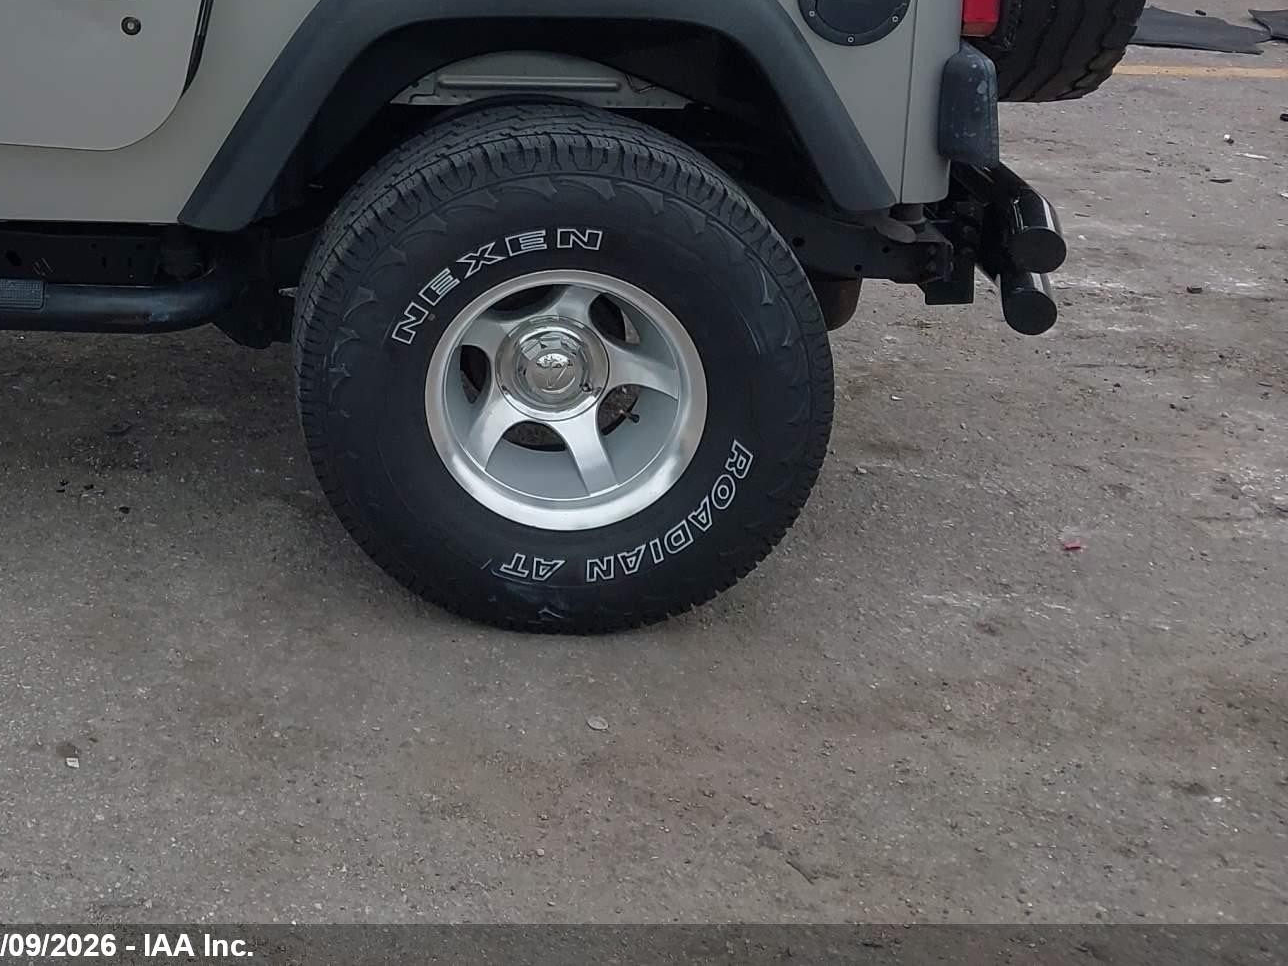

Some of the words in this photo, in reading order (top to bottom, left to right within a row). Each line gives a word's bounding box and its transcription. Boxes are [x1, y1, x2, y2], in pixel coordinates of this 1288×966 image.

[391, 228, 603, 345] NEXEN
[500, 552, 565, 581] AT
[586, 439, 754, 583] ROADIAN
